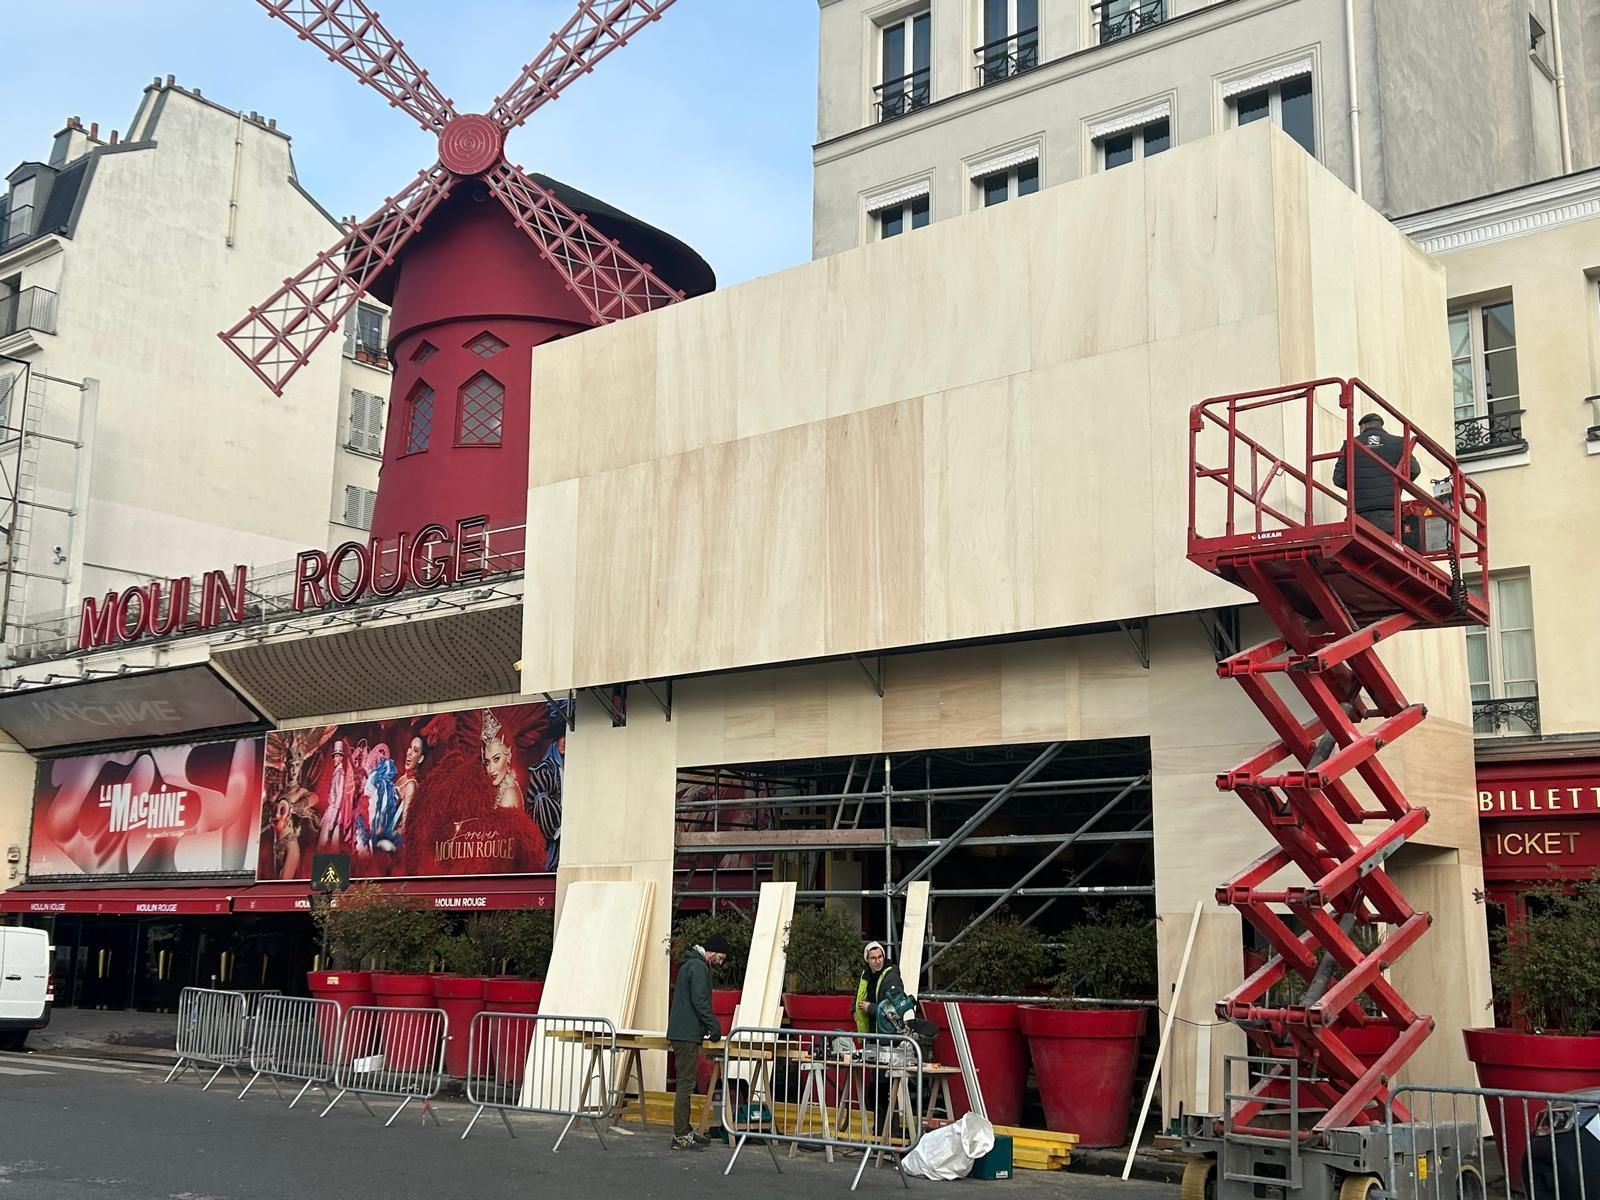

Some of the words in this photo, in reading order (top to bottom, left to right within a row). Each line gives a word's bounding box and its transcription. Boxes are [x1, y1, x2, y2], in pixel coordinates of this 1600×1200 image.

[1257, 531, 1283, 540] LOXAM
[79, 565, 247, 649] MOULIN
[293, 514, 490, 611] ROUGE
[1479, 787, 1600, 811] BILLETT
[447, 817, 499, 841] Forever
[434, 841, 475, 862] MOULIN
[476, 837, 515, 860] ROUGE
[136, 903, 158, 912] MOULIN
[158, 903, 178, 912] ROUGE
[434, 897, 461, 907] MOULIN
[462, 896, 487, 907] ROUGE
